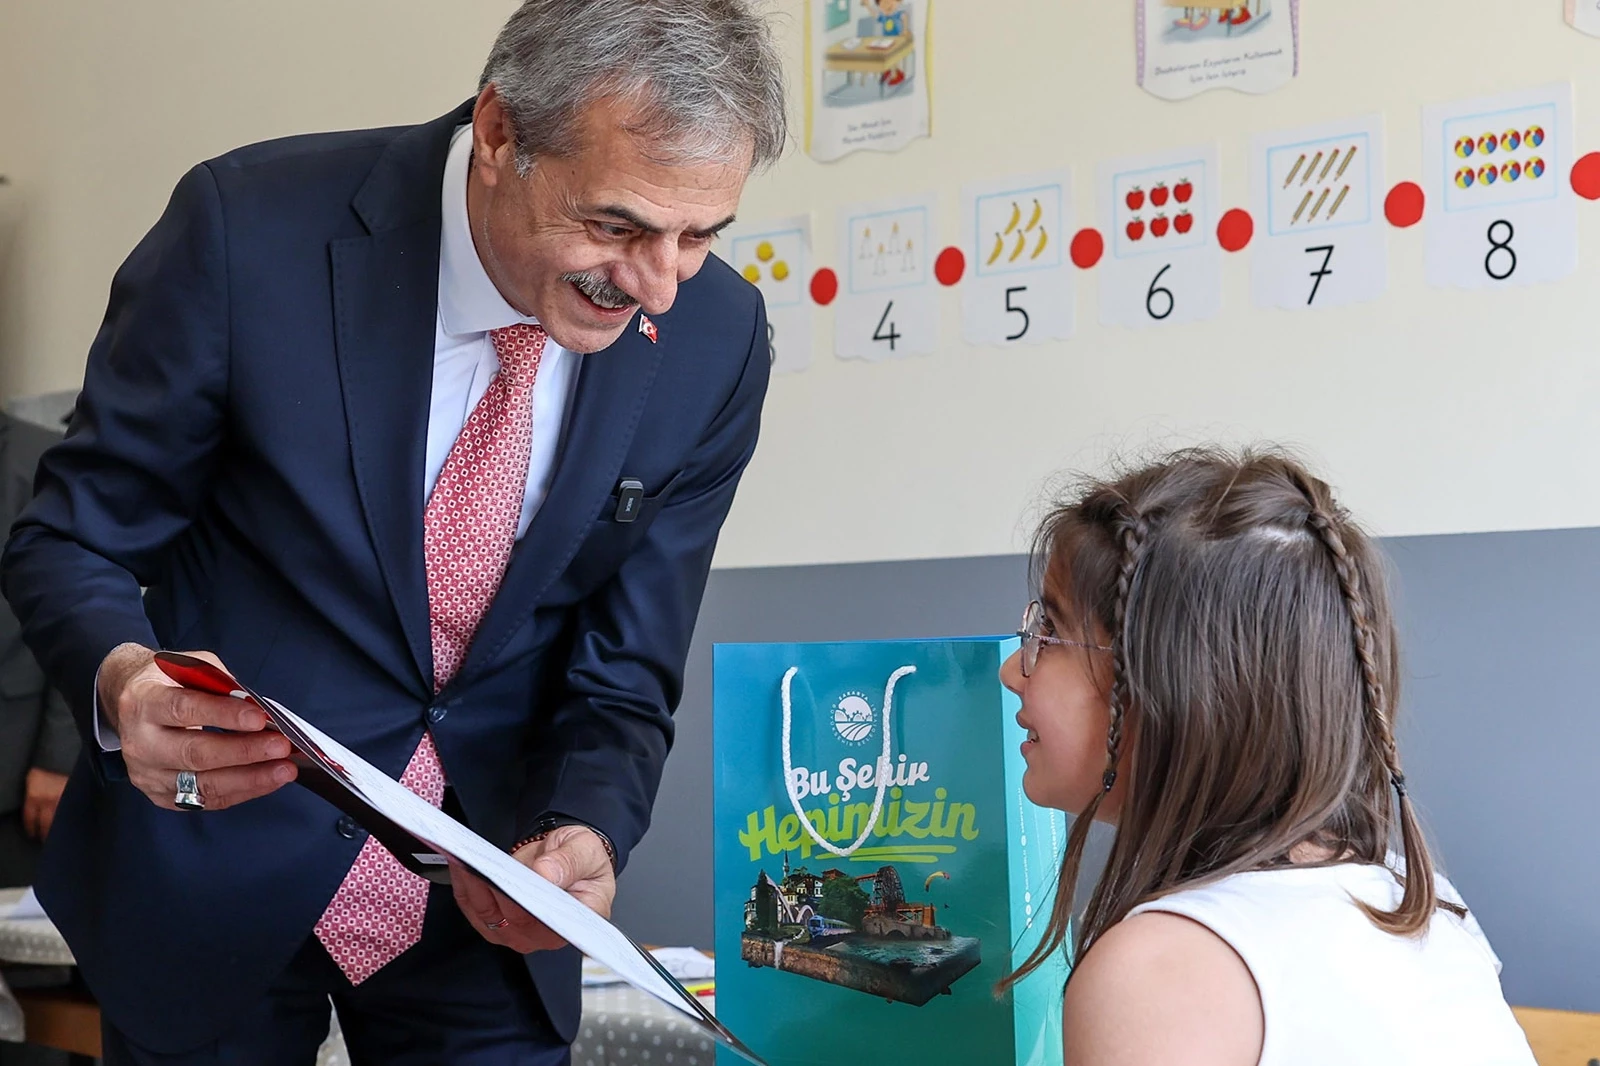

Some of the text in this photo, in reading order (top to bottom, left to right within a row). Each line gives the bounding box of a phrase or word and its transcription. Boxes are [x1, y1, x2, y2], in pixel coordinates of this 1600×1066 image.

[1305, 244, 1335, 306] 7
[1485, 219, 1517, 280] 8
[1005, 286, 1030, 341] 5
[1146, 263, 1174, 320] 6
[872, 300, 901, 351] 4
[838, 691, 868, 701] SAKARYA
[789, 753, 931, 802] Bu Şehir
[738, 786, 980, 862] Hepimizin
